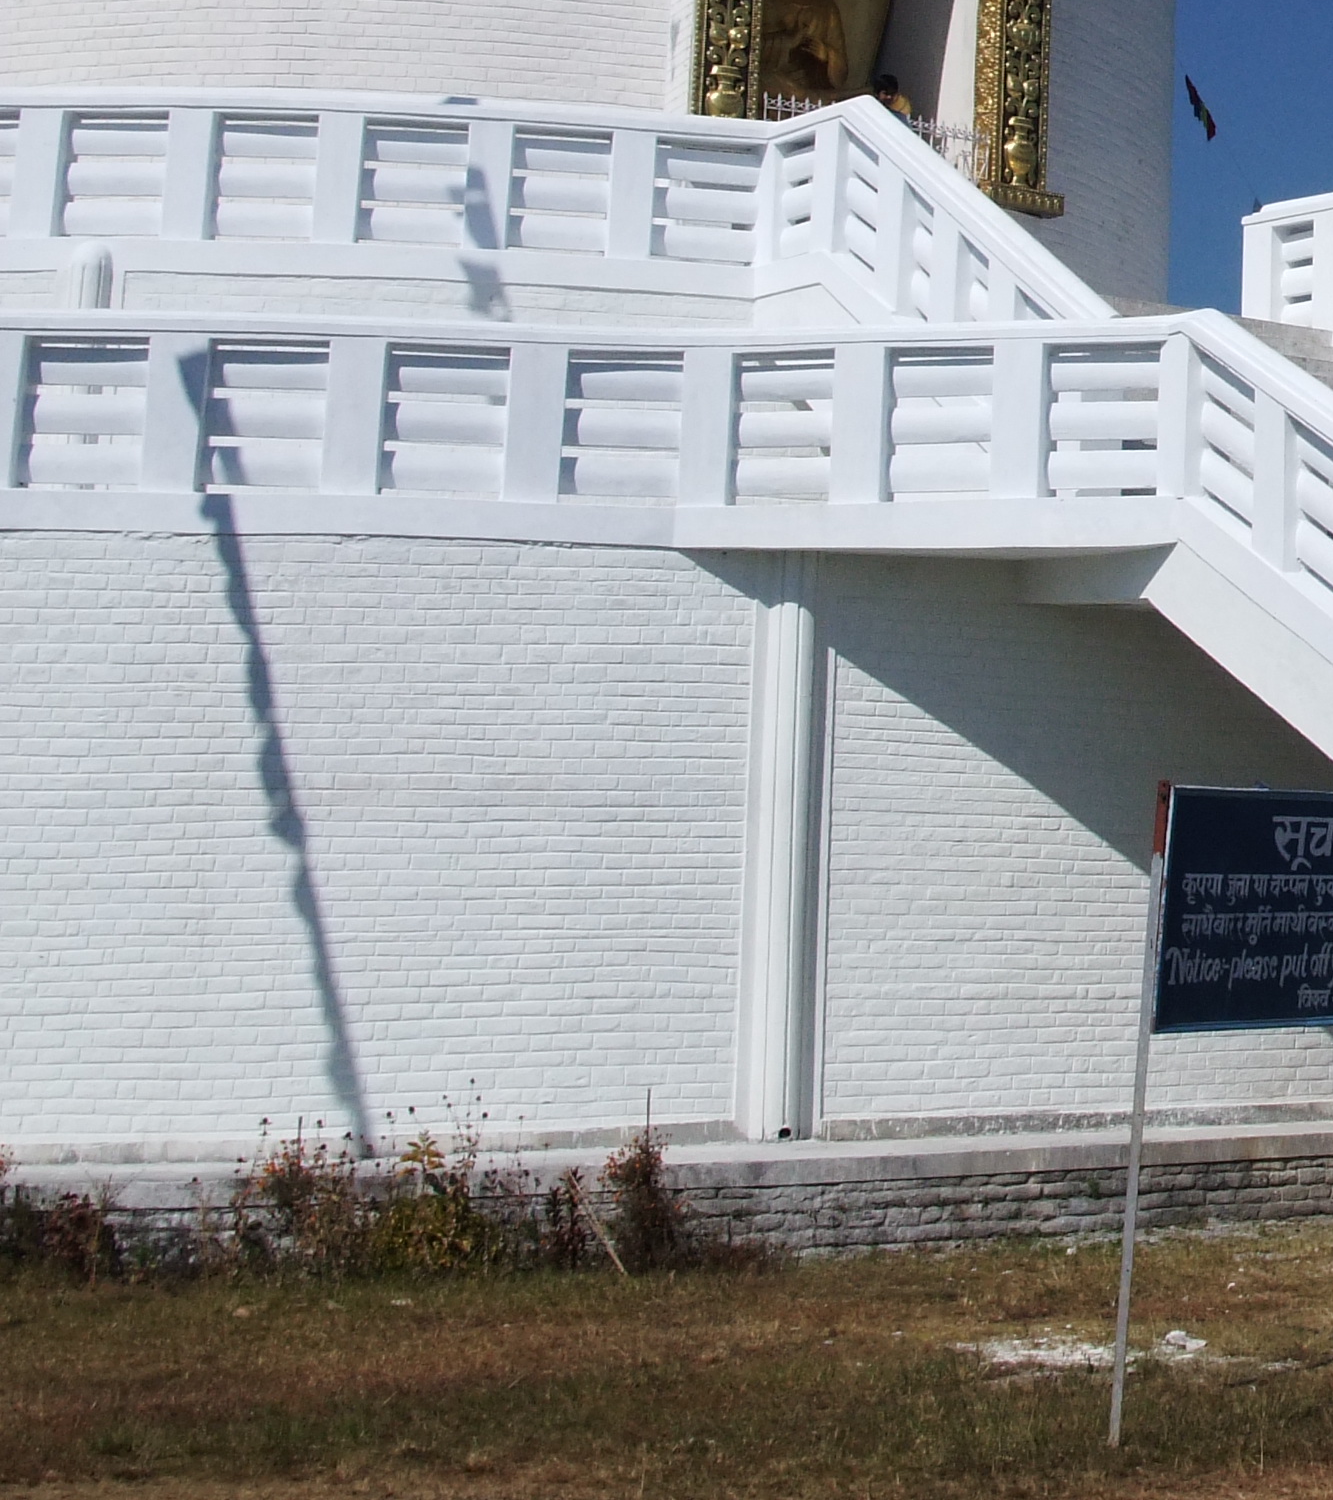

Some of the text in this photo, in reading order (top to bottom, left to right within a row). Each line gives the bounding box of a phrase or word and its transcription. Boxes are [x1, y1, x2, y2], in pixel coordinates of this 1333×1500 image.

[1182, 873, 1223, 905] कृपया
[1271, 874, 1310, 899] चप्पल
[1279, 943, 1309, 988] put
[1310, 942, 1333, 977] off
